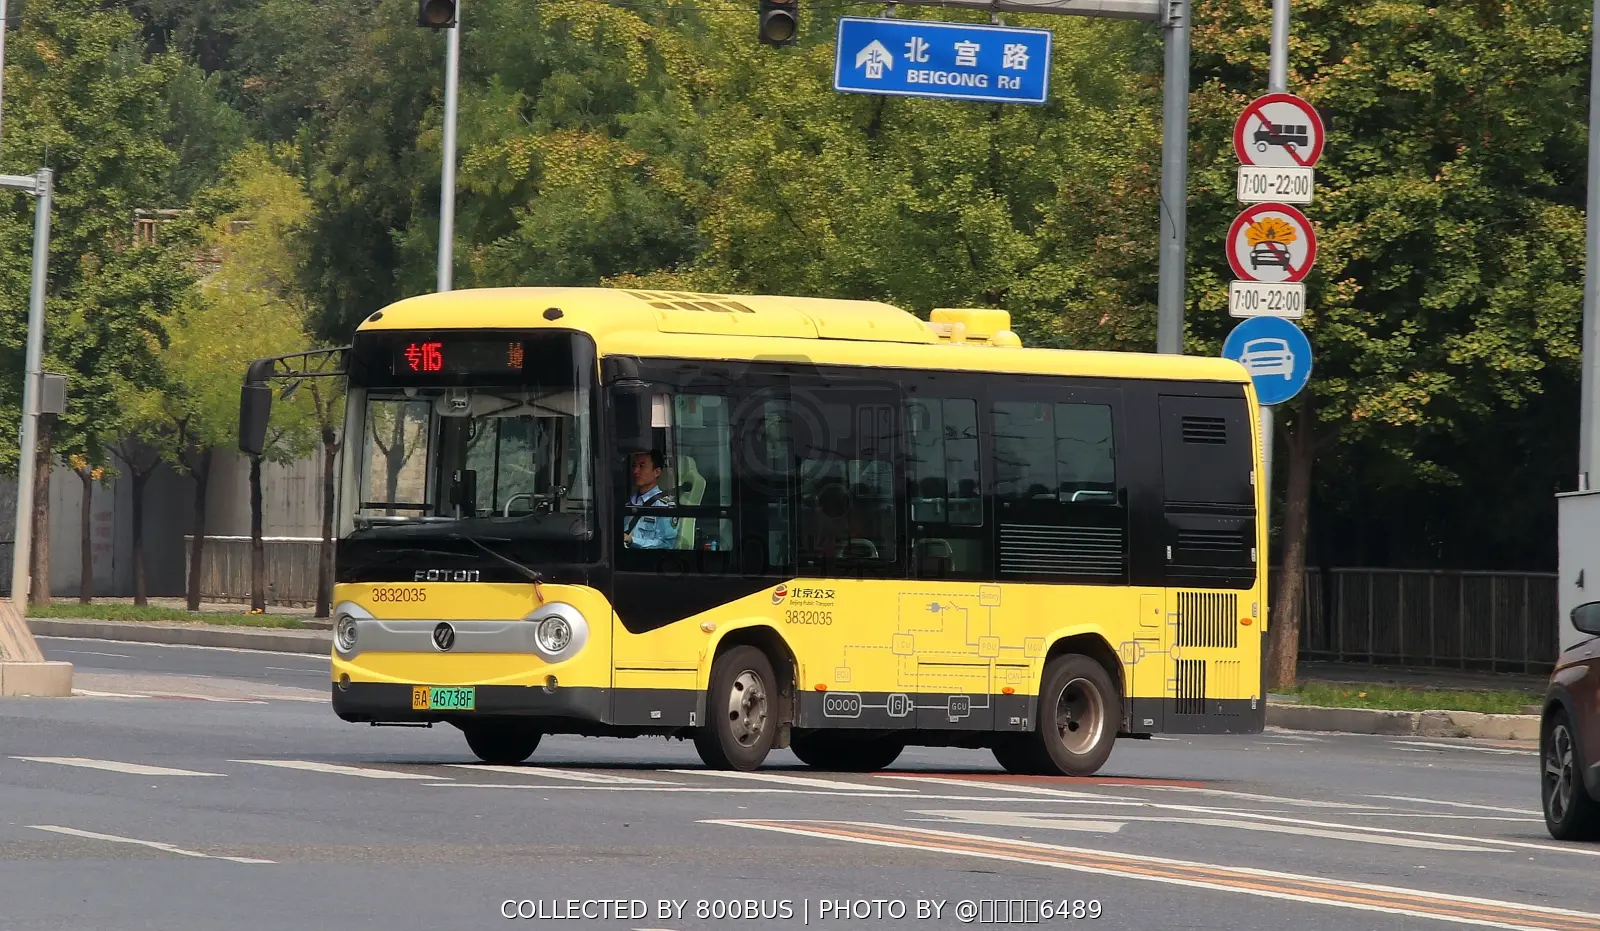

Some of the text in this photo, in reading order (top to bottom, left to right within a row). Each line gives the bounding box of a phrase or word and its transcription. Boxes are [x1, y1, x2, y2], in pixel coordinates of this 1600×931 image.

[868, 49, 882, 63] 北
[904, 36, 1030, 70] 北宫路
[869, 65, 880, 76] N
[906, 69, 1021, 90] BEIGONG Rd
[1242, 173, 1308, 195] 7:00-22:00
[1234, 289, 1301, 311] 7:00-22:00
[404, 342, 443, 371] 专115
[414, 569, 480, 582] FOTON
[372, 588, 427, 602] 3832035
[790, 588, 836, 599] 北京公交
[785, 610, 832, 625] 3832035
[894, 699, 901, 710] G
[951, 702, 967, 711] GCU
